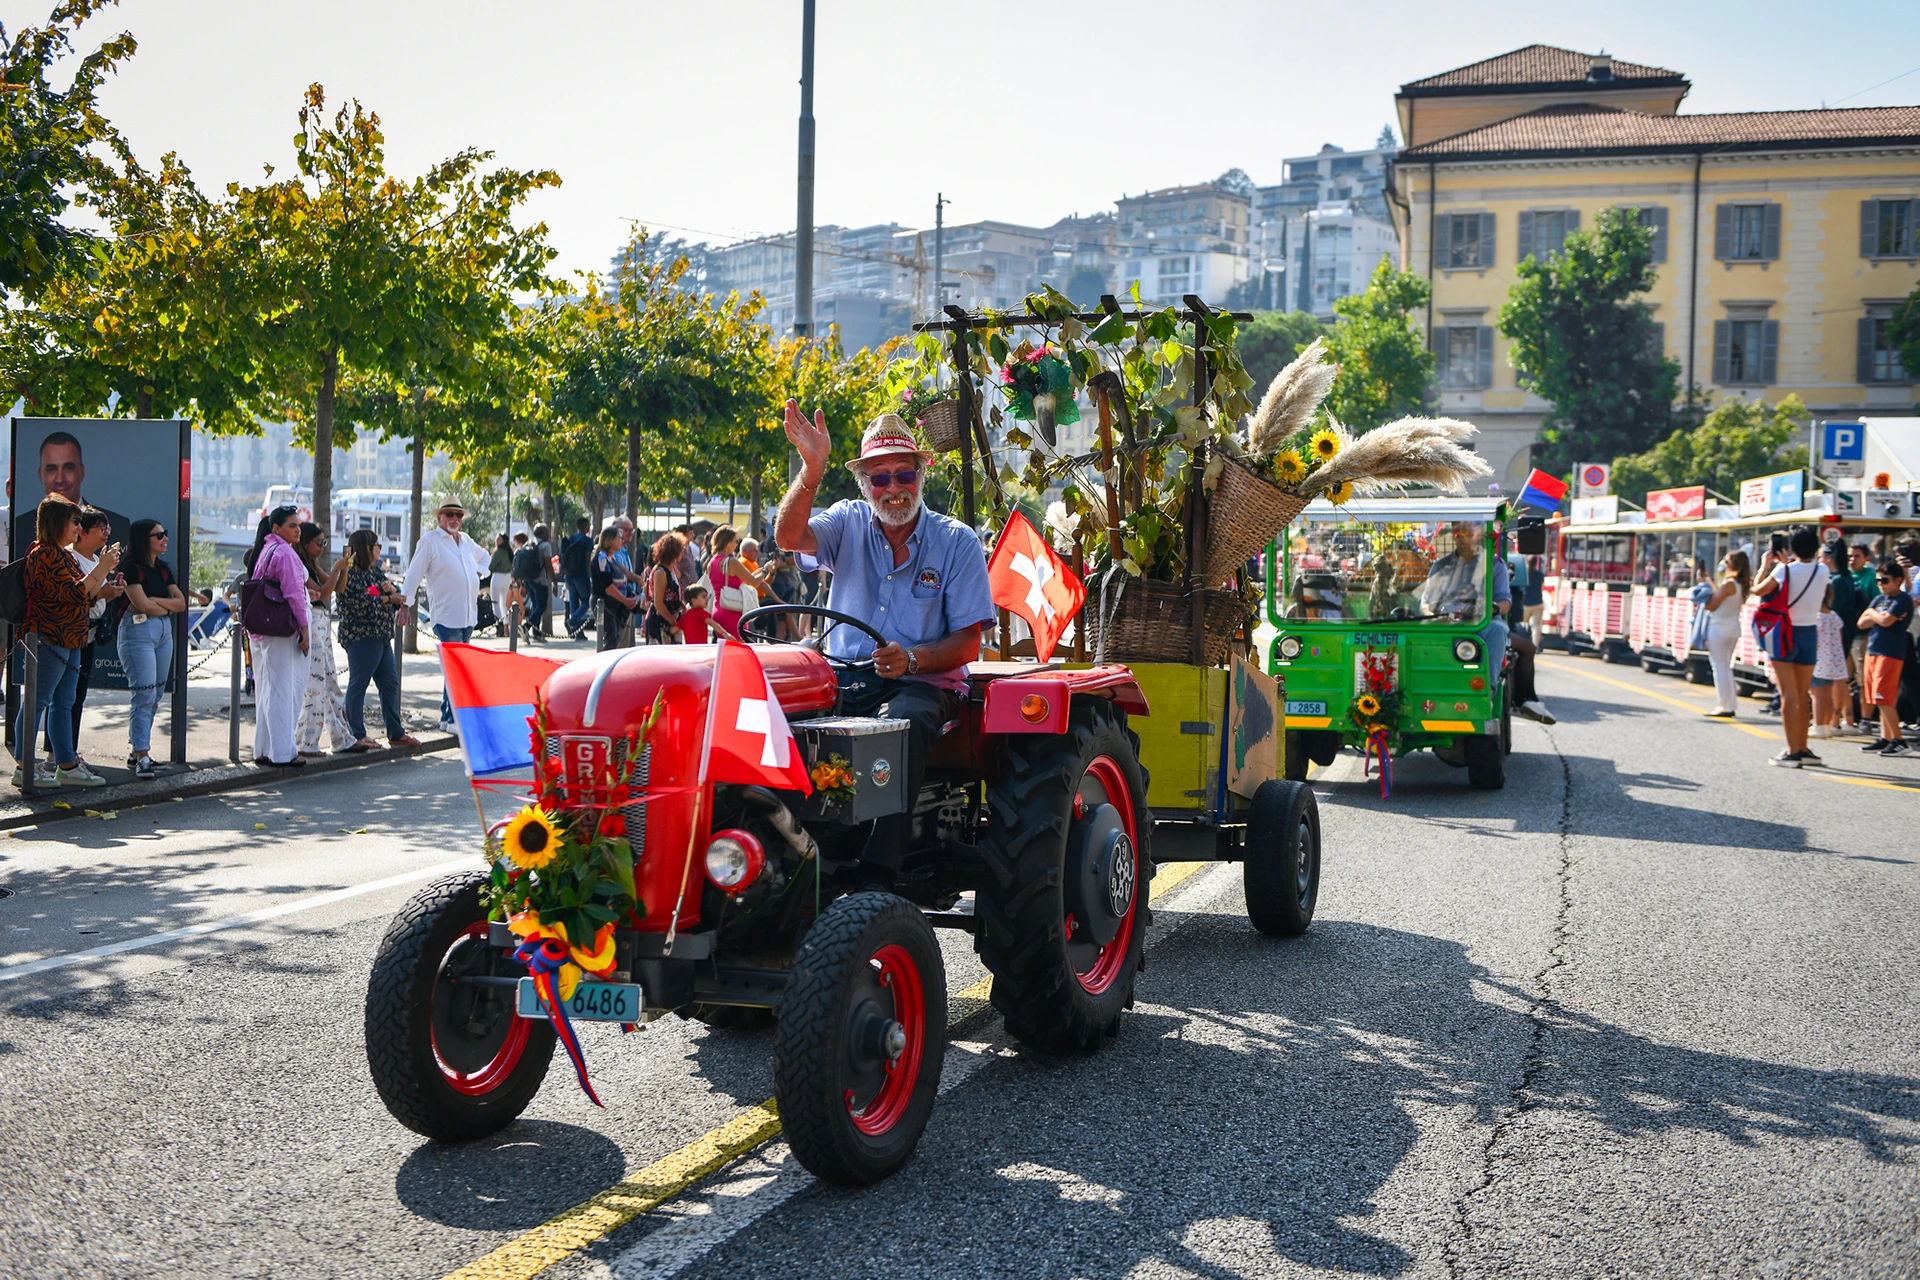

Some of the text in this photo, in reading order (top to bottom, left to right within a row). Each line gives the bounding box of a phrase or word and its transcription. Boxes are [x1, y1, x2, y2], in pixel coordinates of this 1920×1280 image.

[1834, 429, 1855, 456] P
[1826, 530, 1839, 541] 30
[1354, 632, 1399, 645] SCHILTER
[95, 658, 123, 669] group
[1298, 702, 1321, 714] 2858
[573, 986, 626, 1016] 6486
